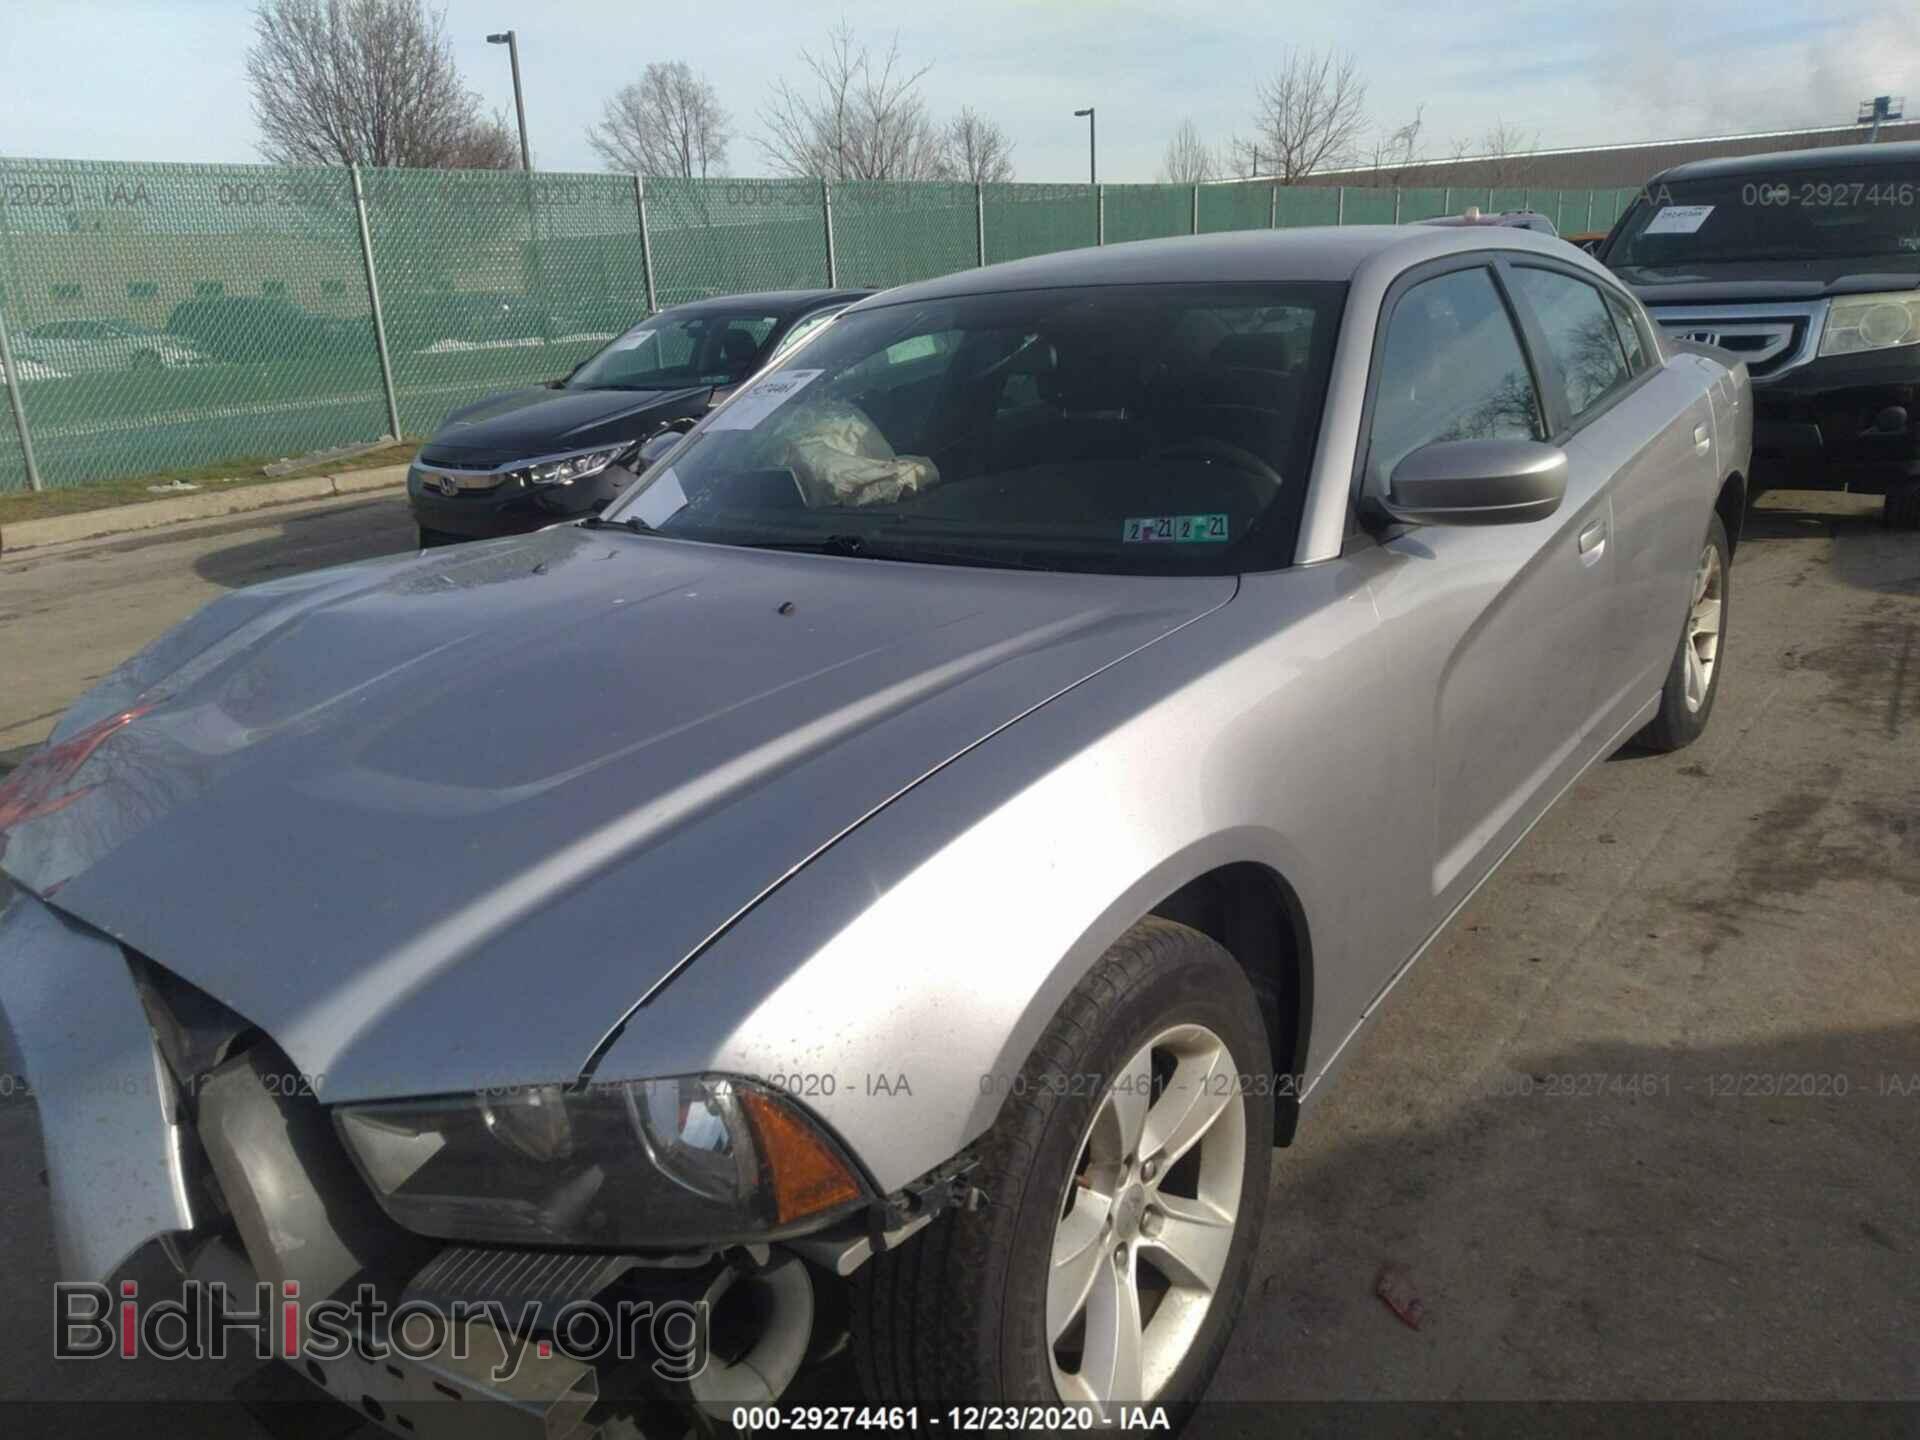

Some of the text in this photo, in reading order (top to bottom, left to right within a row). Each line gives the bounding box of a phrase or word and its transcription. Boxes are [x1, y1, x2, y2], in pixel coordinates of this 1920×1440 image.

[1130, 519, 1172, 540] 2 21
[1182, 516, 1225, 538] 2 21
